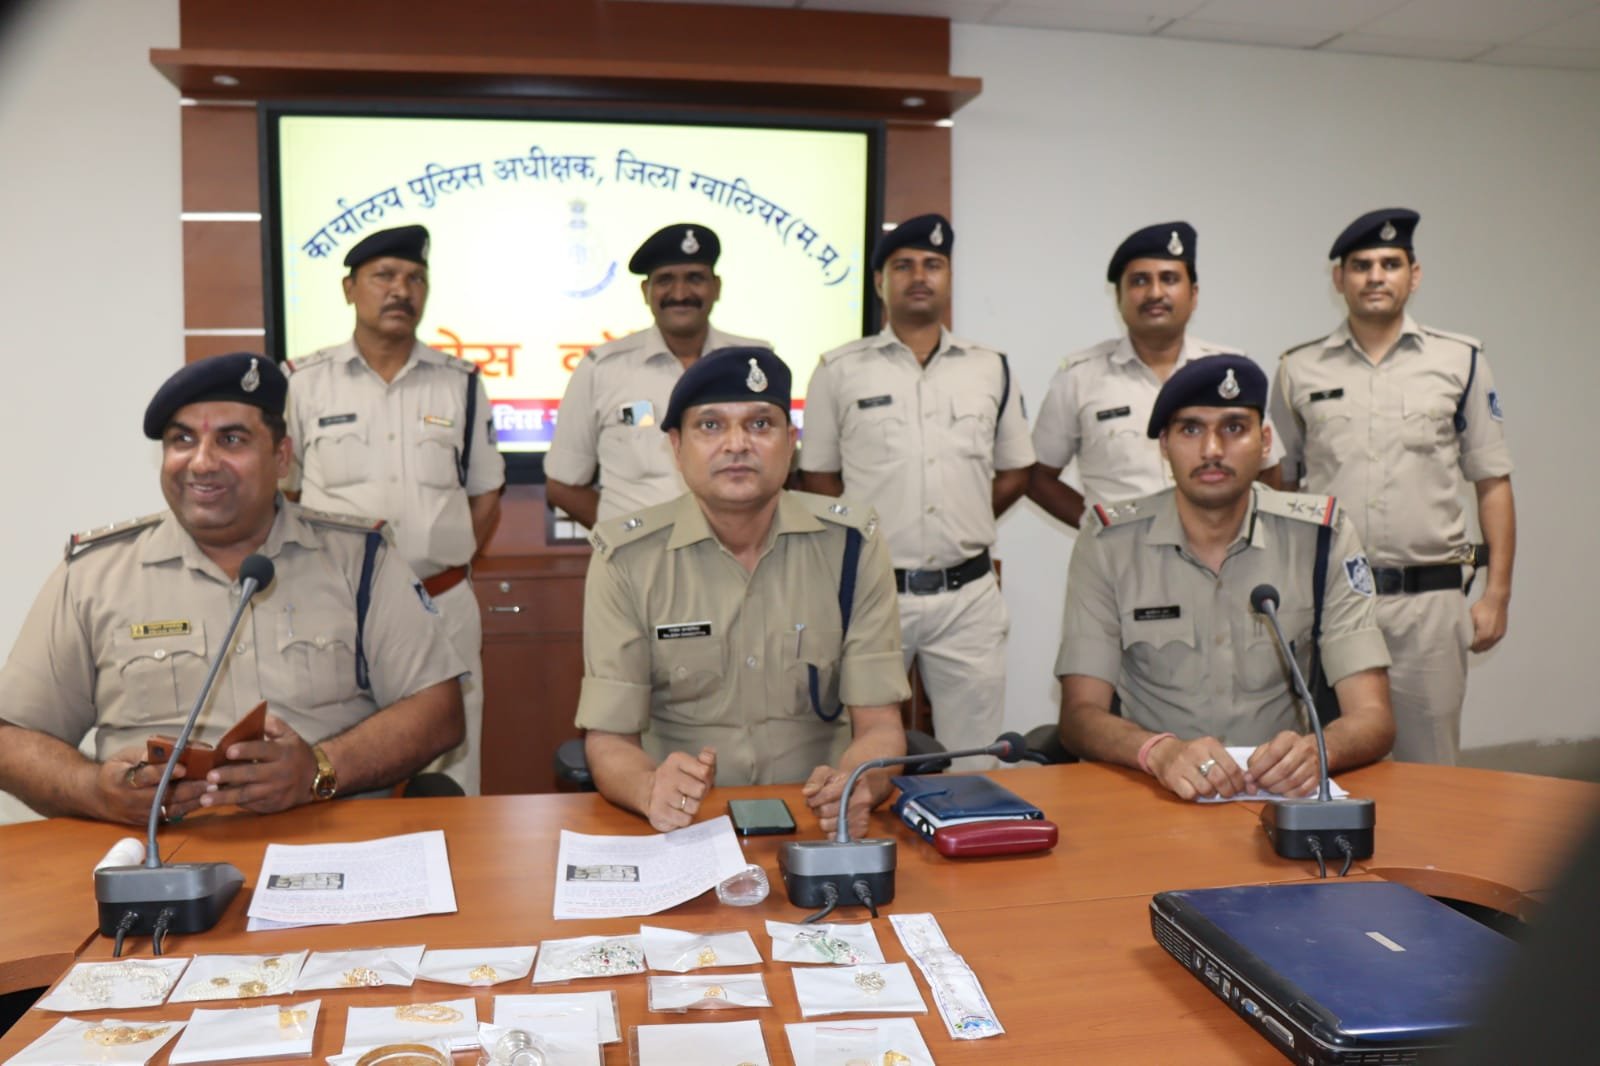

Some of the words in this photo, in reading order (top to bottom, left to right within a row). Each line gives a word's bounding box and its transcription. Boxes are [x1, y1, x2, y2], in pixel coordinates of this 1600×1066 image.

[301, 186, 405, 260] कार्यालय
[406, 162, 485, 209] पुलिस
[493, 145, 604, 188] अधीक्षक,
[614, 148, 681, 192] जिला
